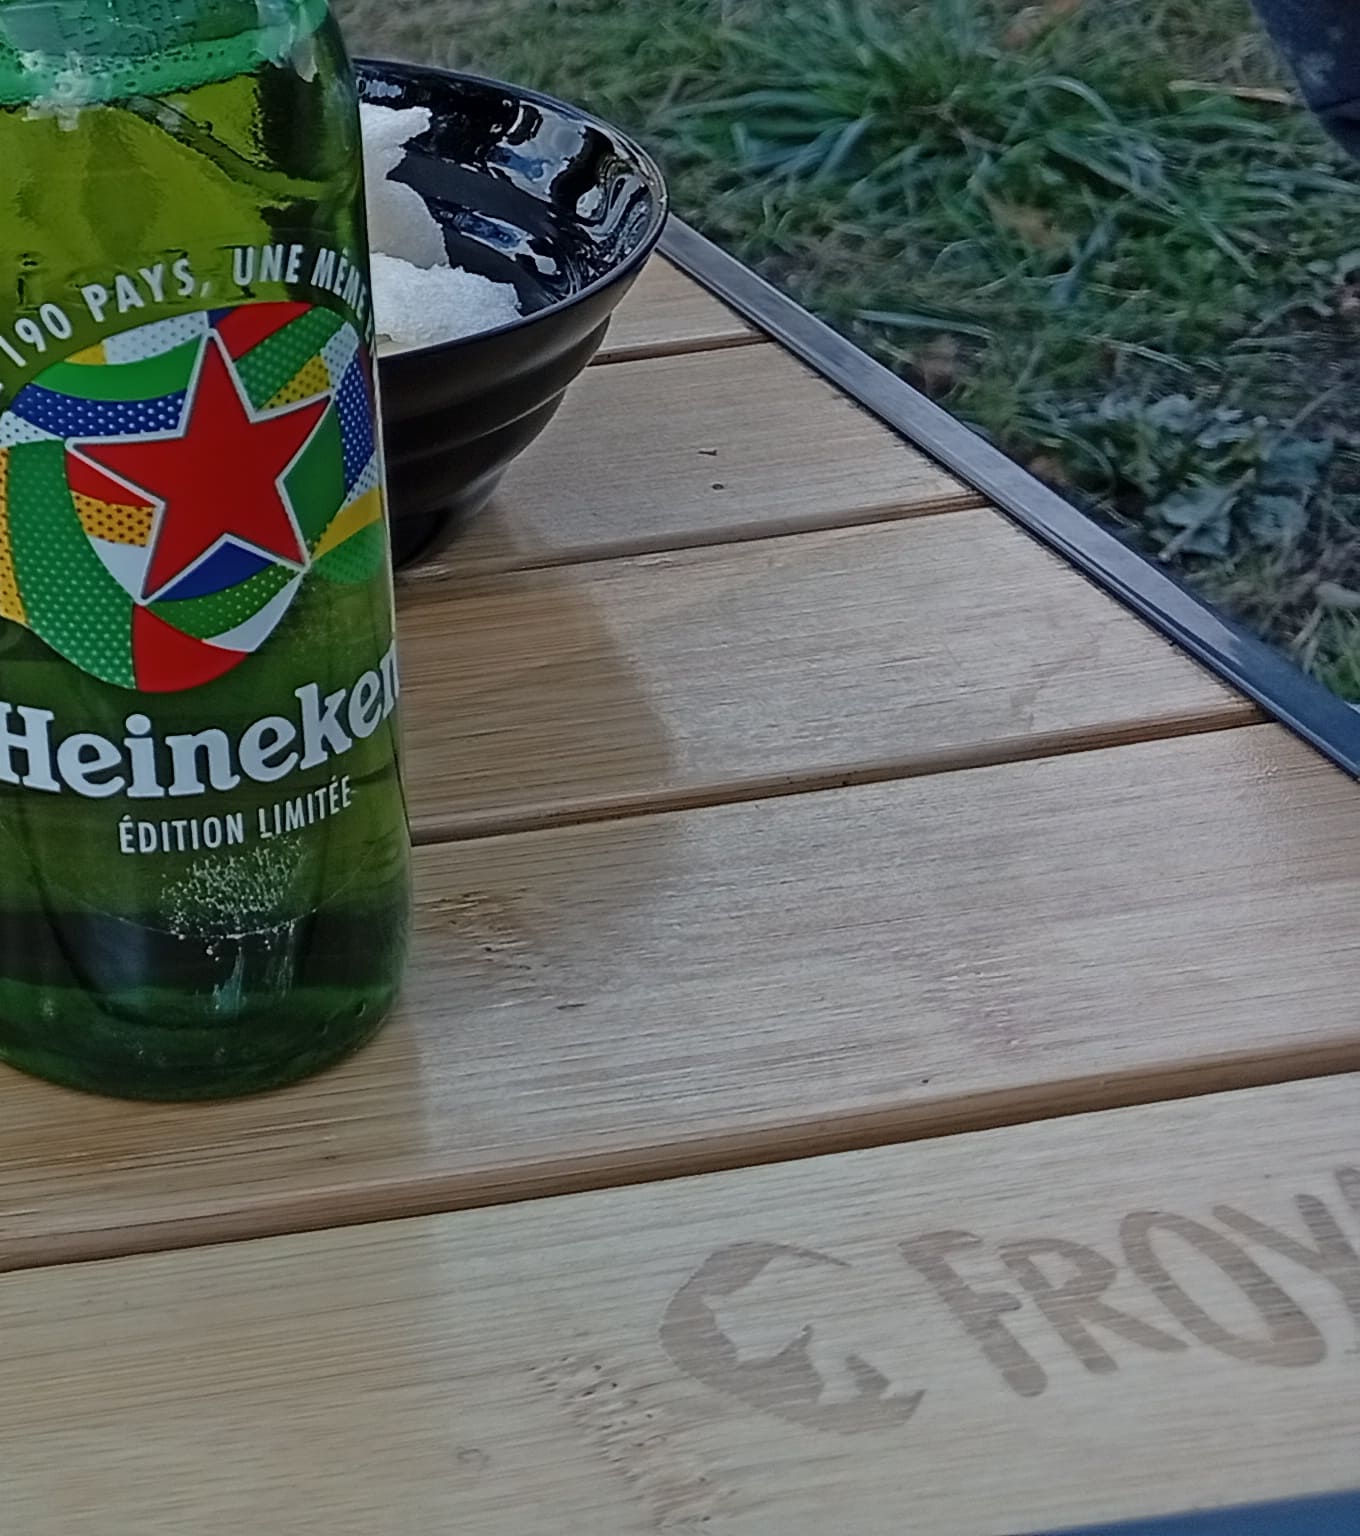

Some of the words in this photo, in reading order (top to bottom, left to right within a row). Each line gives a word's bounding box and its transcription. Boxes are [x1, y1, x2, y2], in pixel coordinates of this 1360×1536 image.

[83, 257, 212, 323] PAYS,
[232, 244, 303, 287] UNE
[118, 812, 245, 857] ÉDITION
[259, 775, 352, 840] LIMITÉE
[897, 1167, 1360, 1398] FROY
